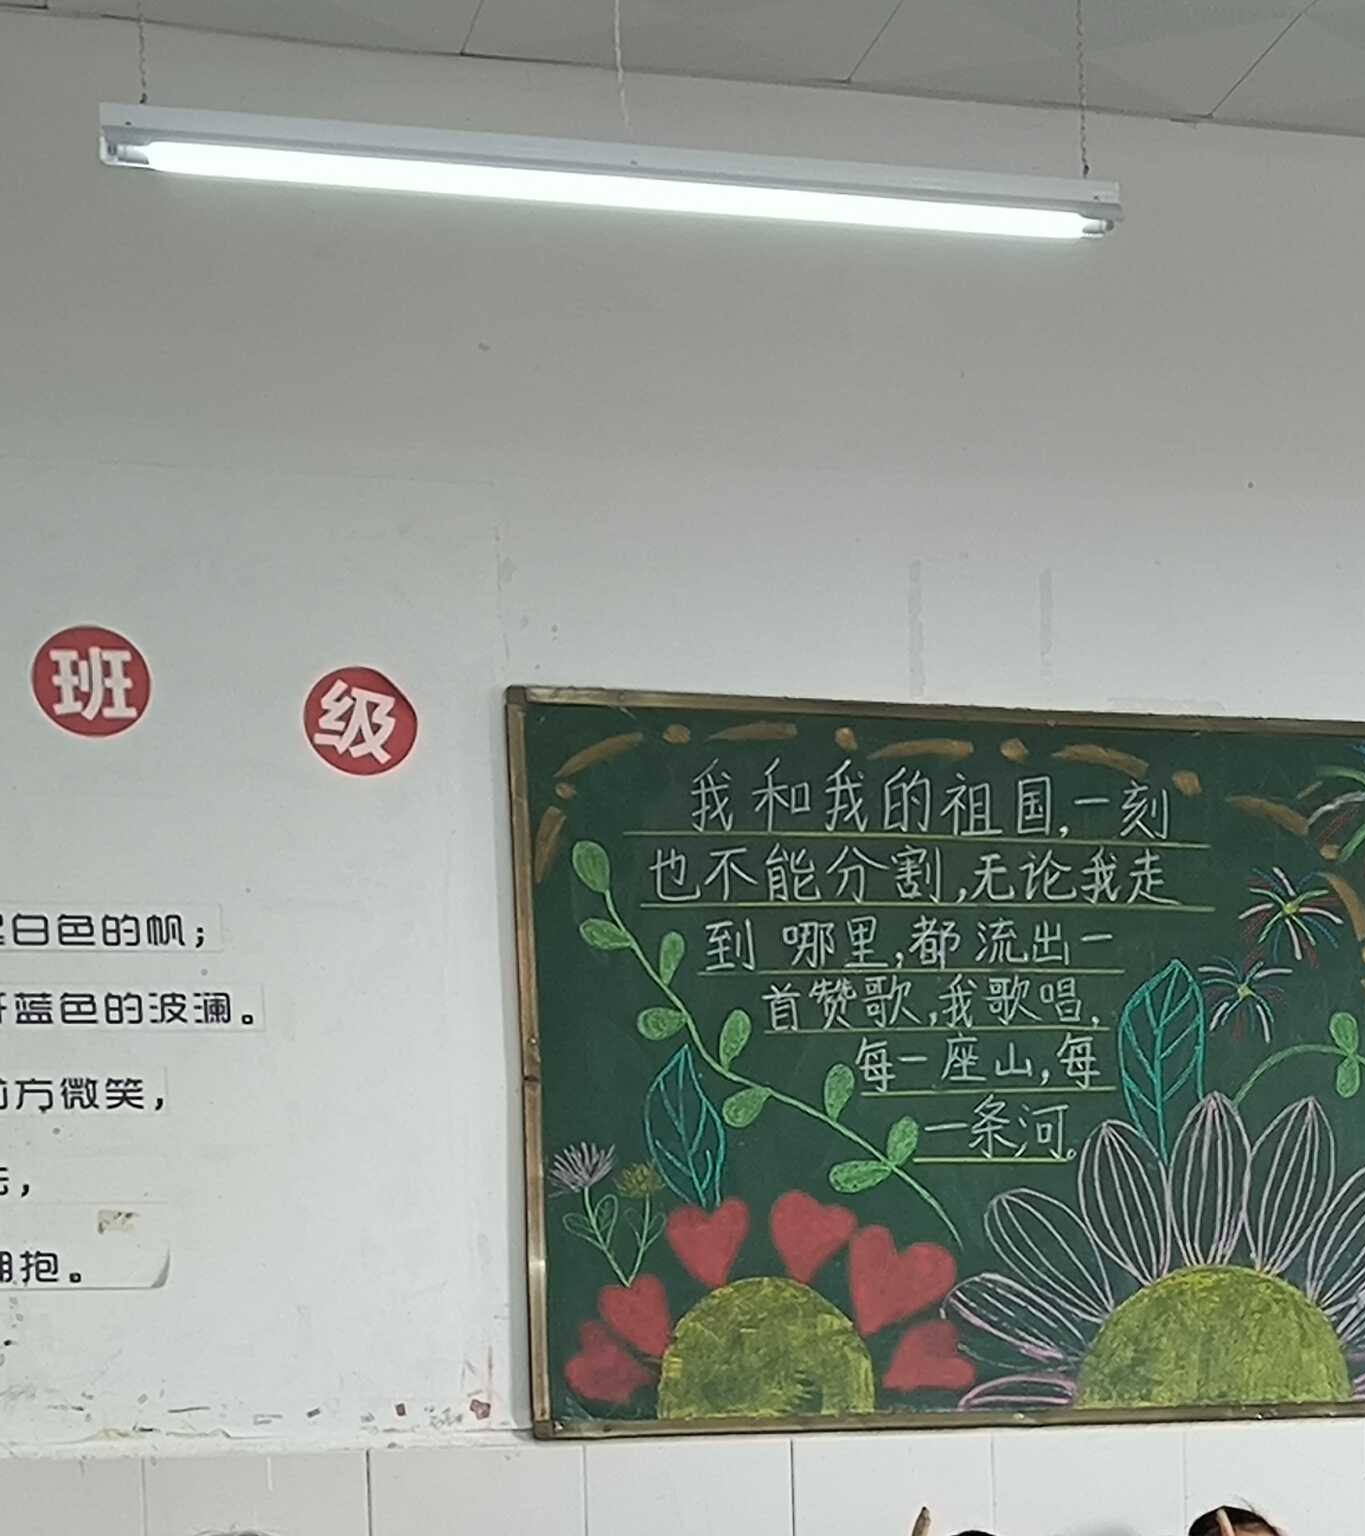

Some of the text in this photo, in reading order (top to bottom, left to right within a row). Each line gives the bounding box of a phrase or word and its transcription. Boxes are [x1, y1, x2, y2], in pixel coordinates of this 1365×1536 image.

[691, 756, 1169, 842] 我和我的祖国，一刻
[648, 842, 1182, 905] 也不能分割，无论我走
[0, 992, 255, 1025] 蓝色的波澜。
[855, 1031, 1101, 1093] 每一座山，每
[924, 1093, 1078, 1161] 一条河。
